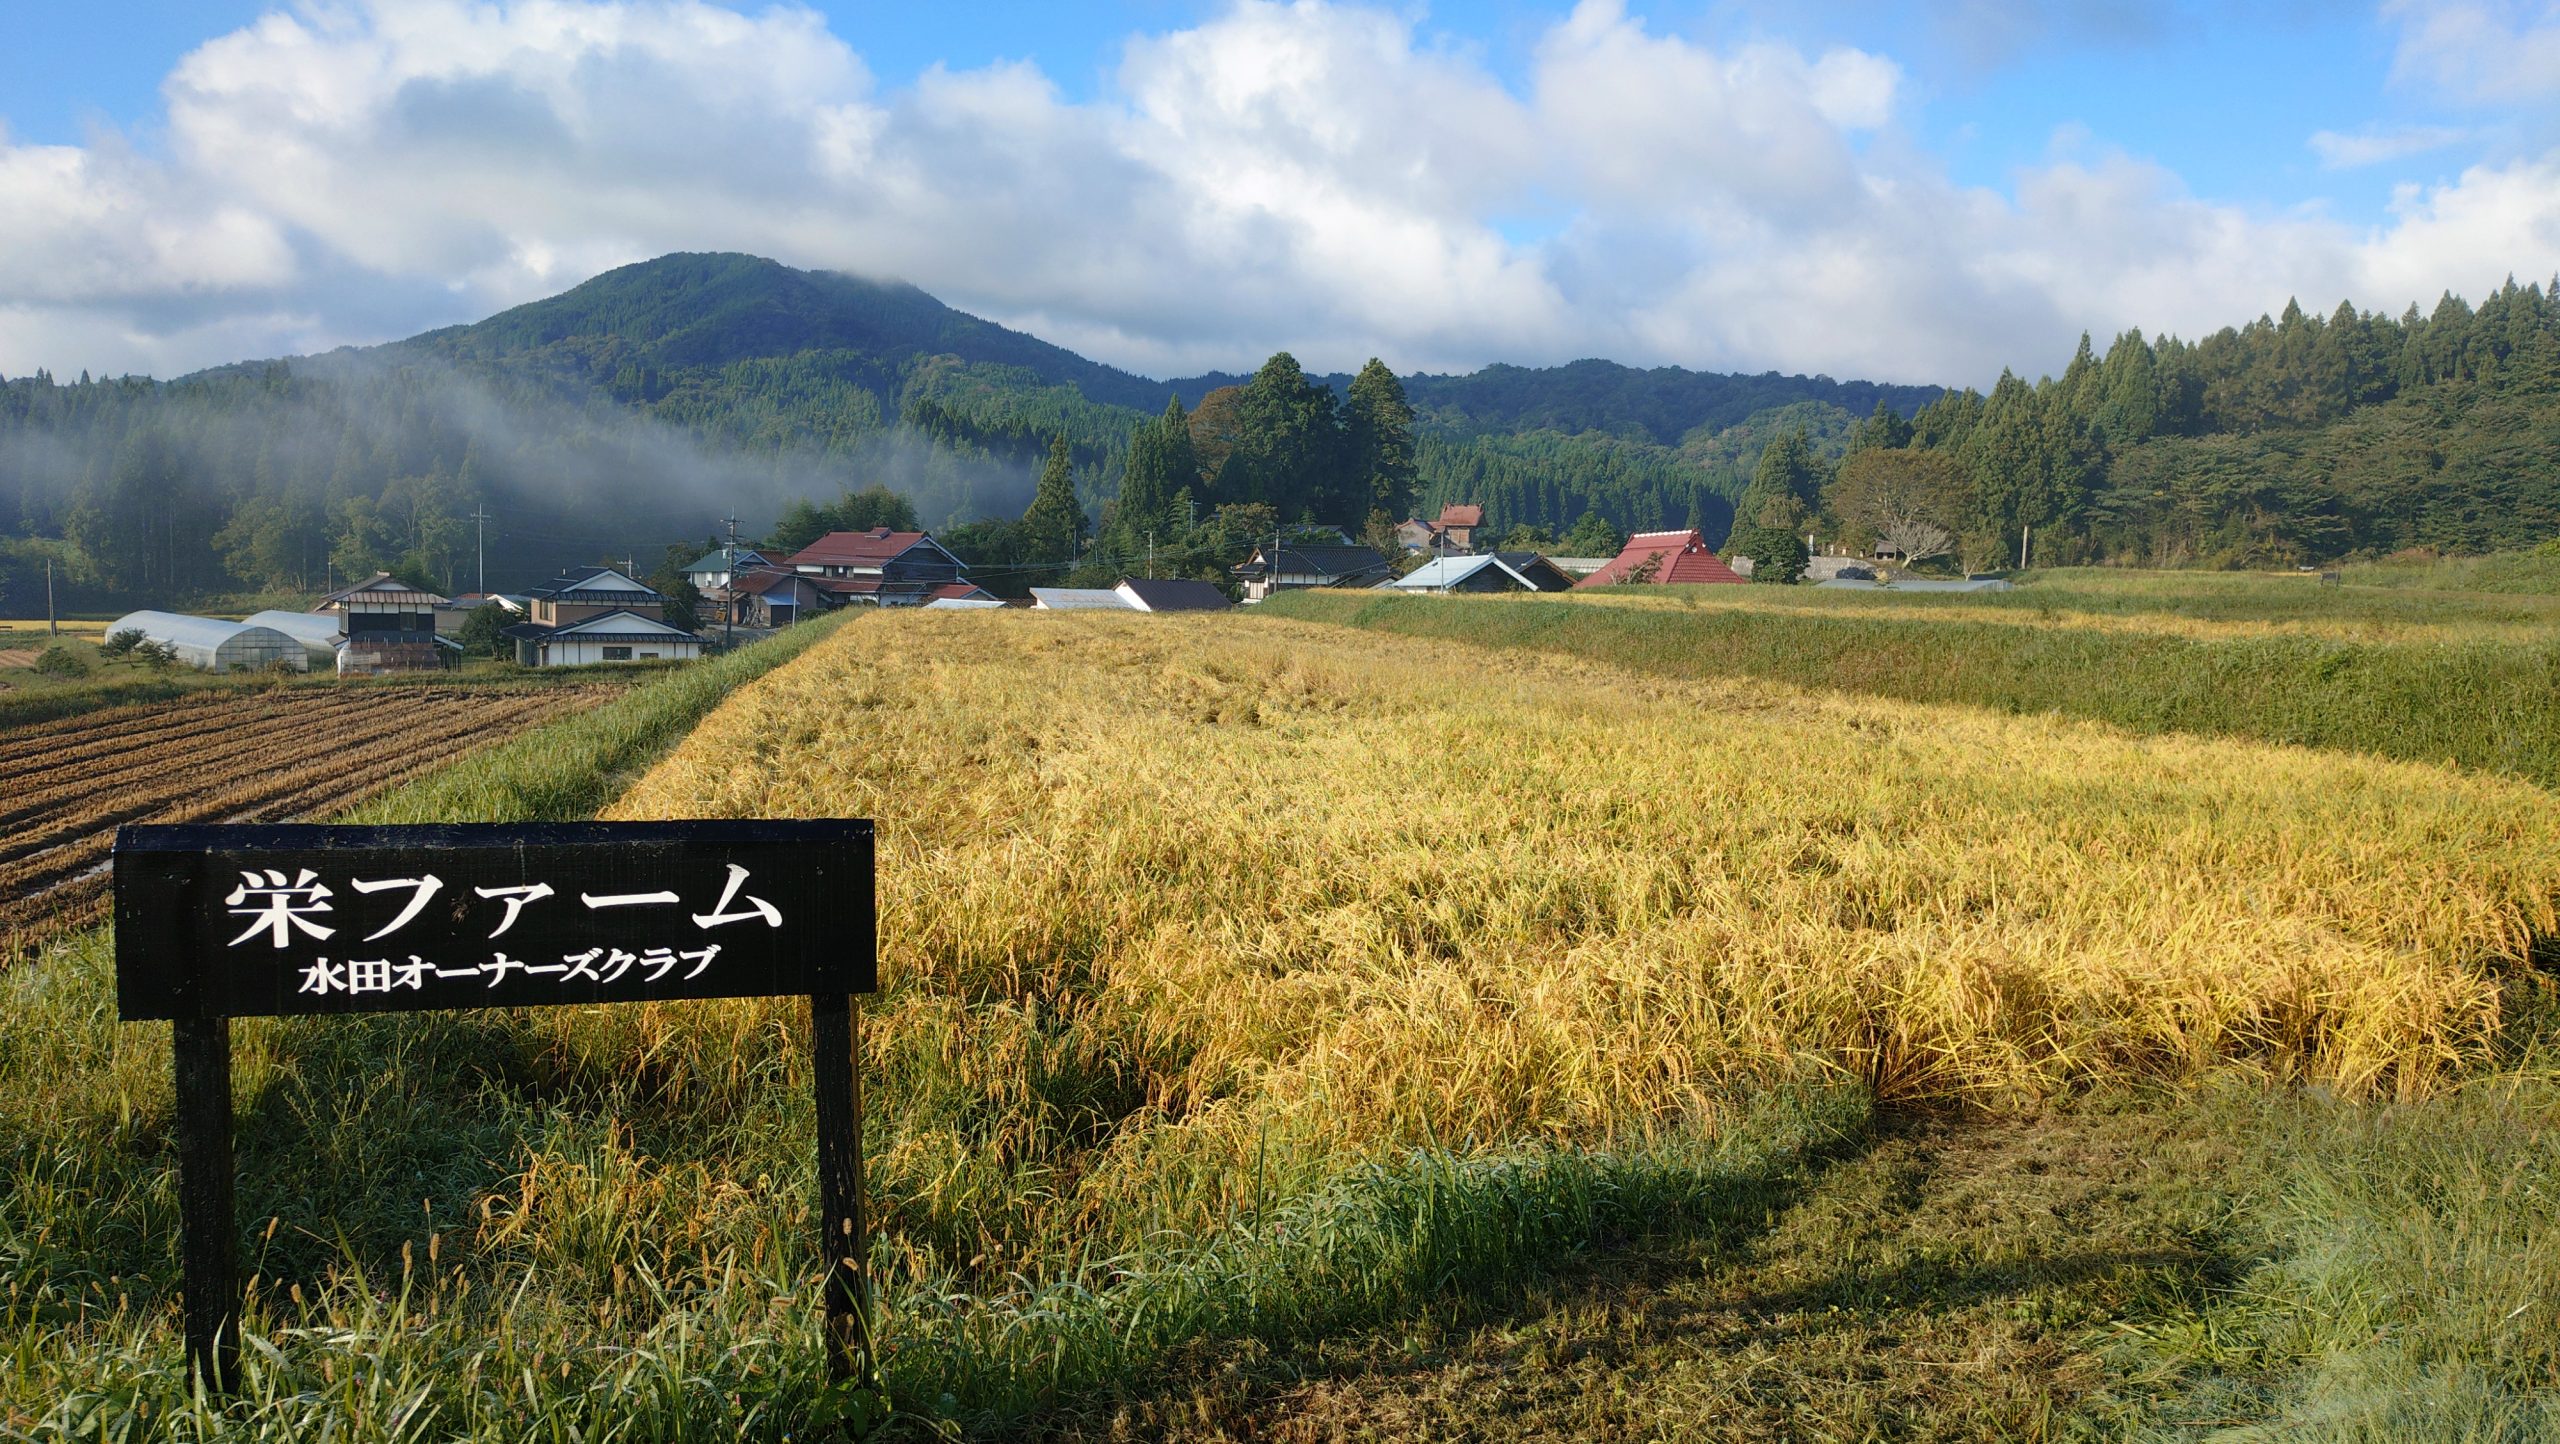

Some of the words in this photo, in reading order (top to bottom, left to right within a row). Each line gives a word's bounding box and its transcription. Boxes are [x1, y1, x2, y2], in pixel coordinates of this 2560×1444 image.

[225, 863, 783, 949] 栄ファーム
[297, 944, 722, 995] 水田オーナーズクラブ
